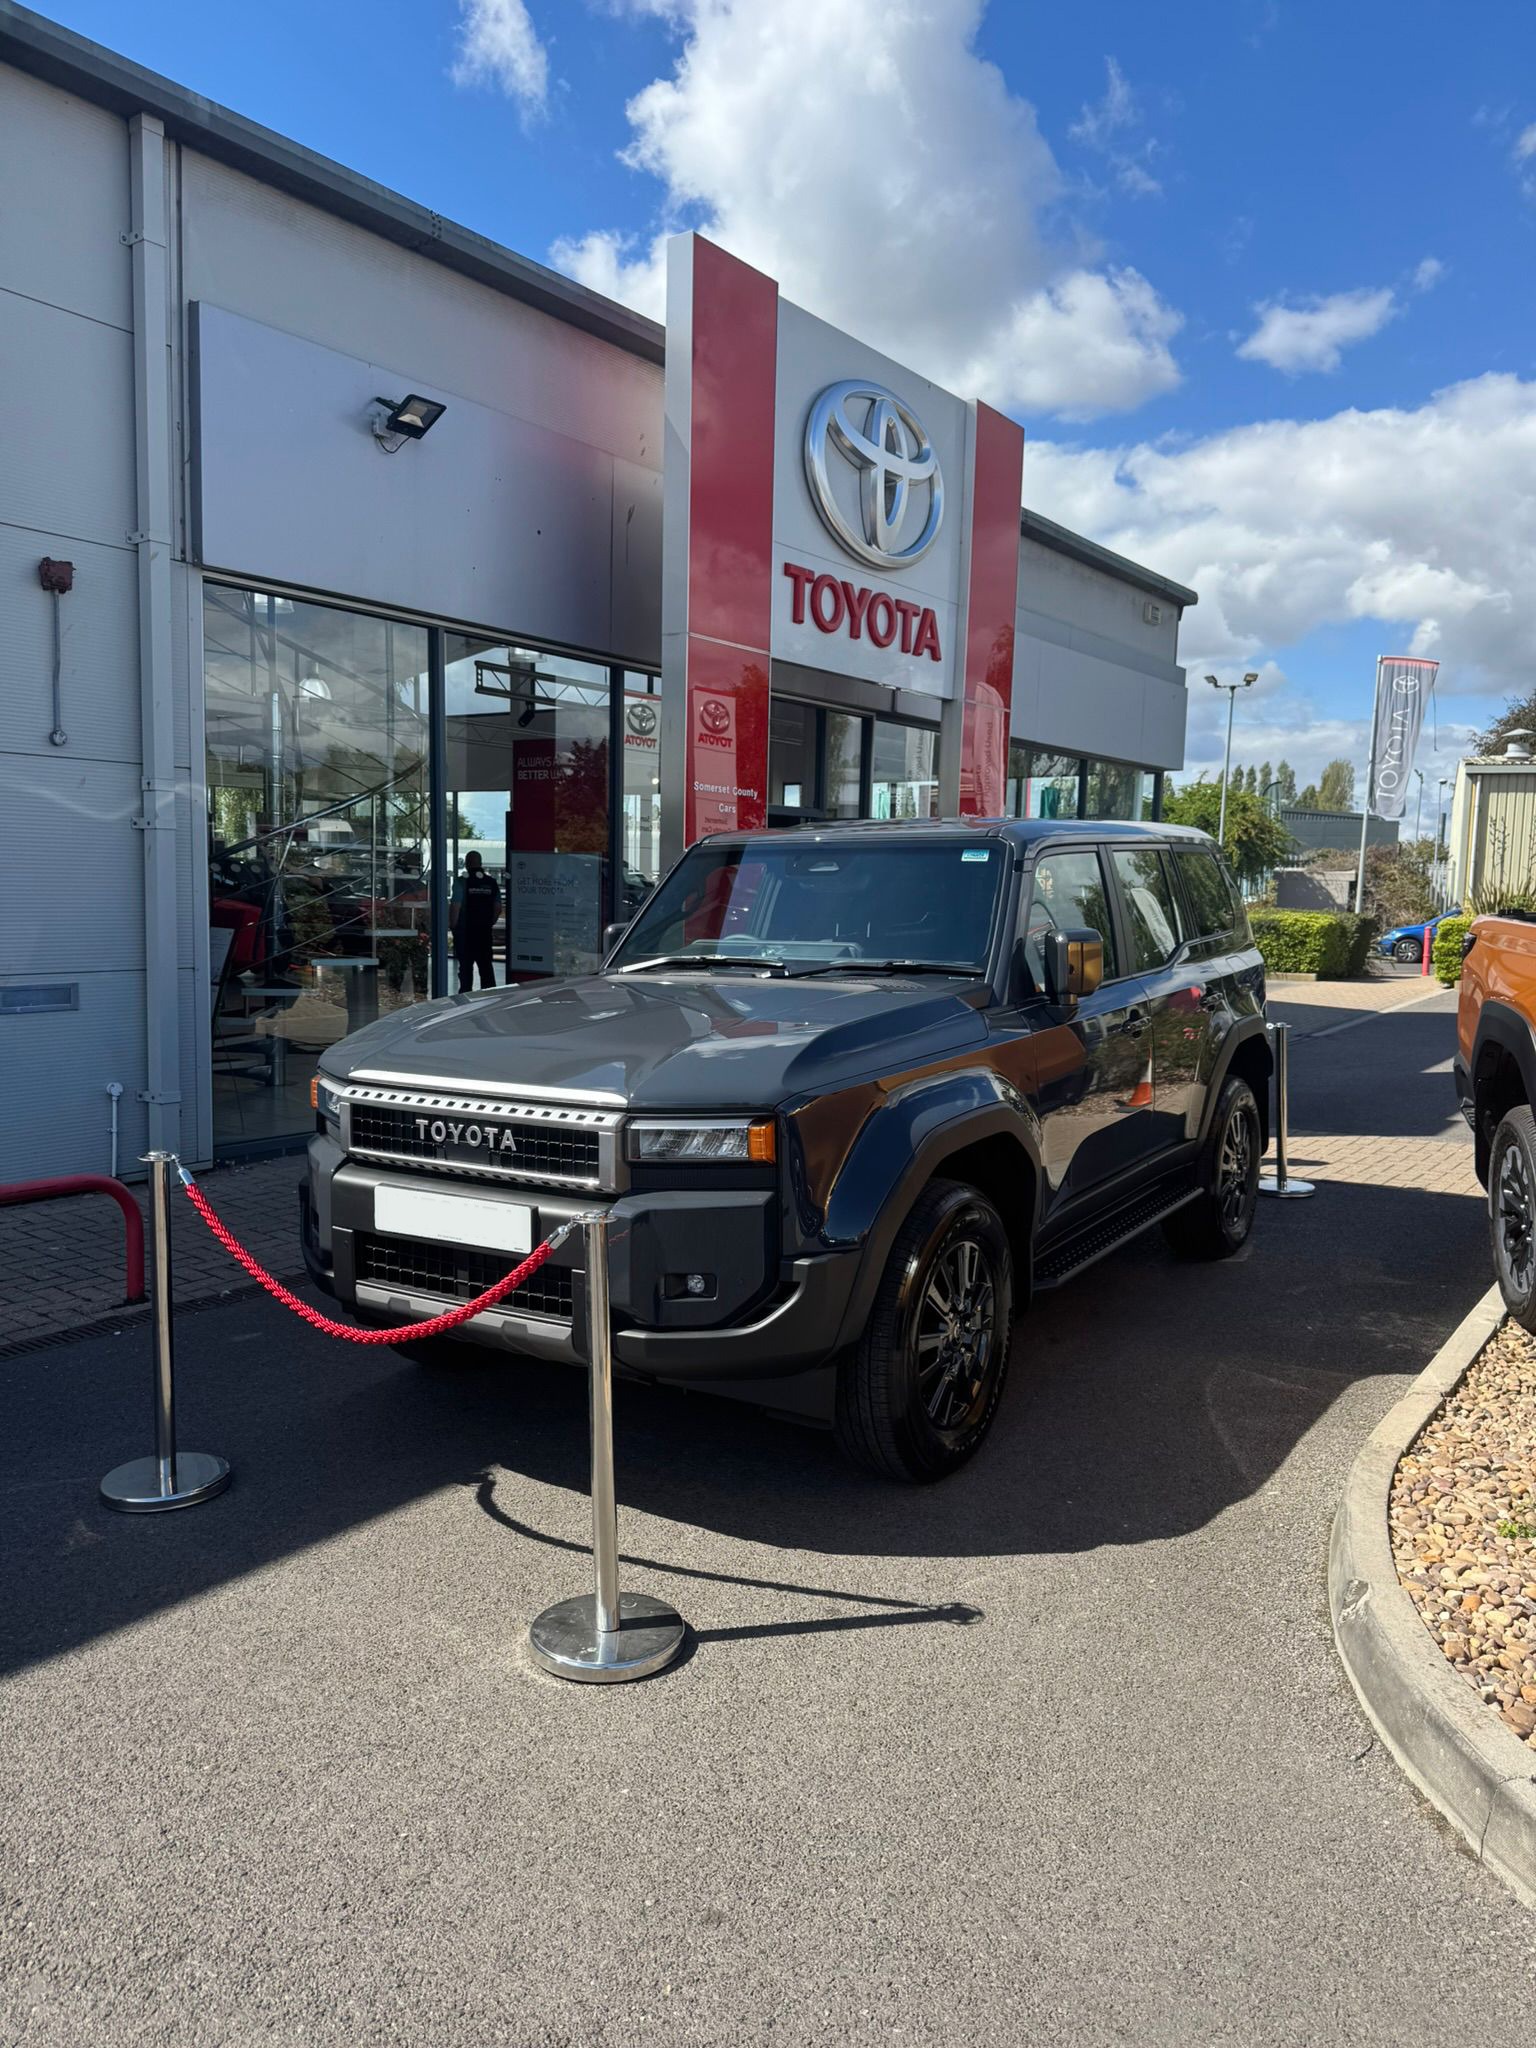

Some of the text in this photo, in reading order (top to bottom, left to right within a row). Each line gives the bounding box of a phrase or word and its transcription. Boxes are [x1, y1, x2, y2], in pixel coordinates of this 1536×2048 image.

[783, 562, 942, 662] TOYOTA
[517, 757, 551, 767] ALWAYS
[1376, 708, 1410, 799] TOYOTA
[517, 770, 549, 780] BETTER
[693, 781, 758, 800] Somerset County
[719, 803, 736, 813] Cars
[415, 1119, 517, 1151] TOYOTA
